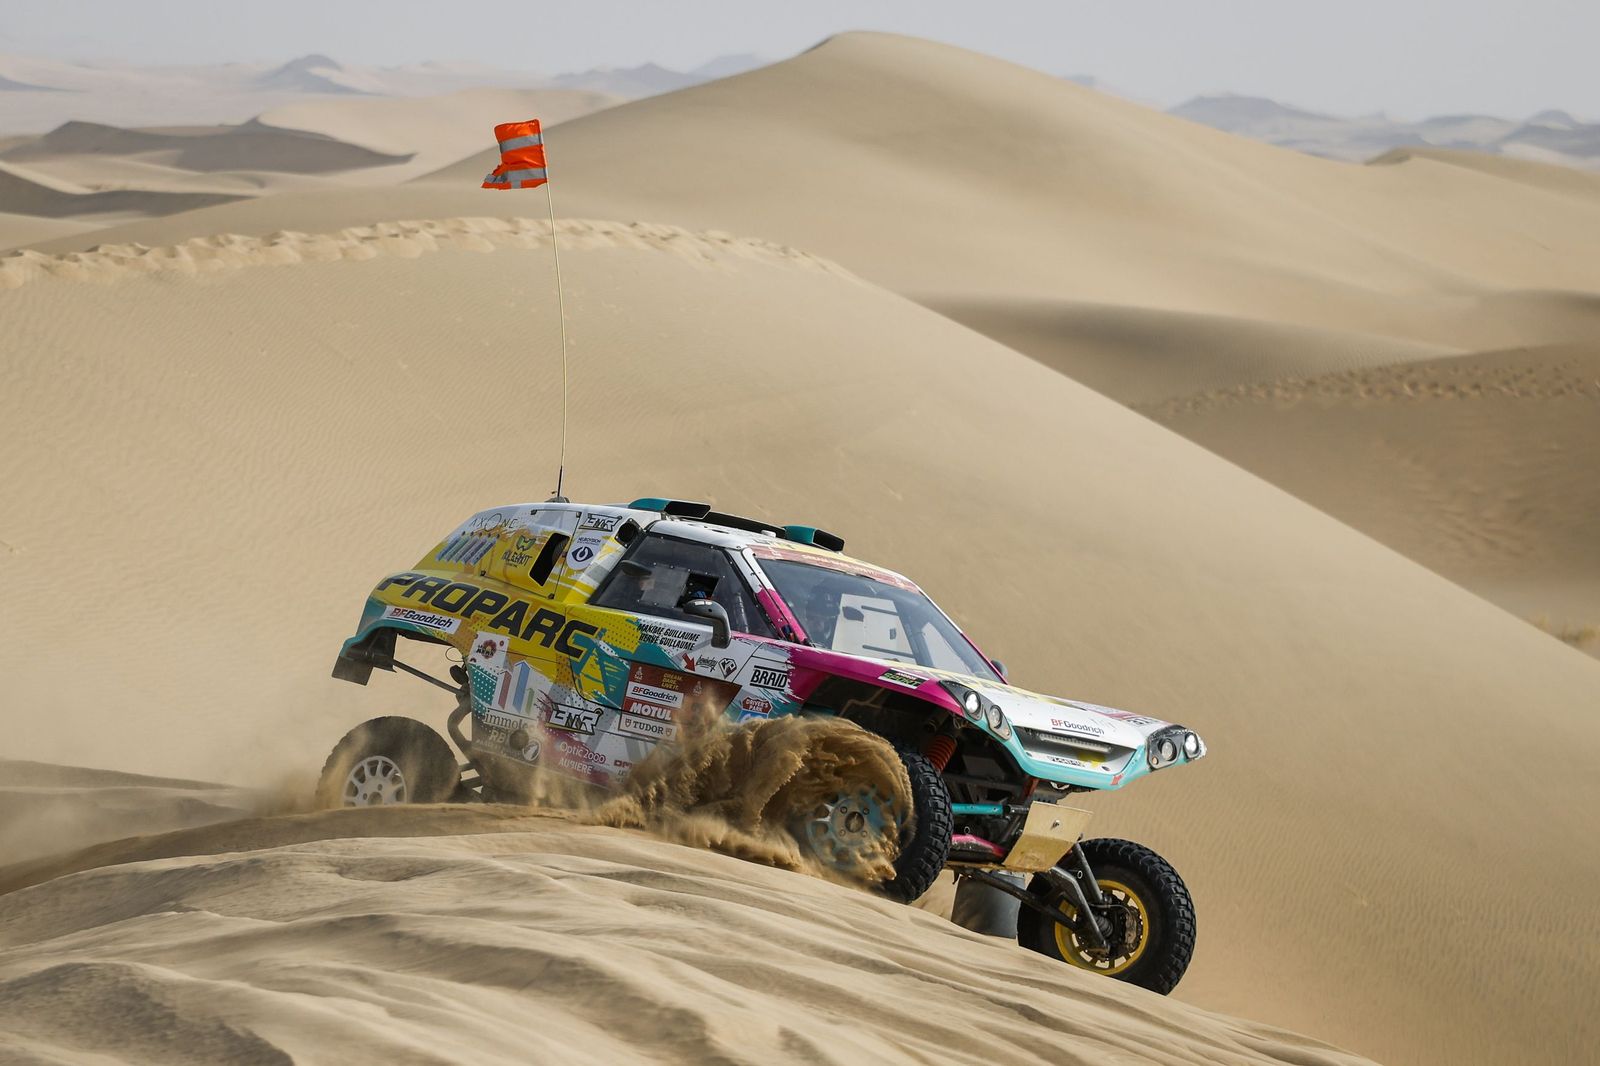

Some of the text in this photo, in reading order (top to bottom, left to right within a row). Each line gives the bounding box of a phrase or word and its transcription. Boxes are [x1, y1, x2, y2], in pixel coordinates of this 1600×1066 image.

[377, 572, 599, 659] PROPARC
[391, 607, 453, 629] BFGoodrich
[637, 623, 701, 642] MAXIME GUILLAUME
[660, 637, 696, 651] GUILLAUME
[751, 669, 788, 688] BRAID
[632, 685, 678, 702] BFGoodrich
[629, 702, 672, 720] MOTUL
[632, 721, 664, 735] TUDOR
[1051, 718, 1105, 735] BFGoodrich
[560, 741, 606, 764] Optic 2000
